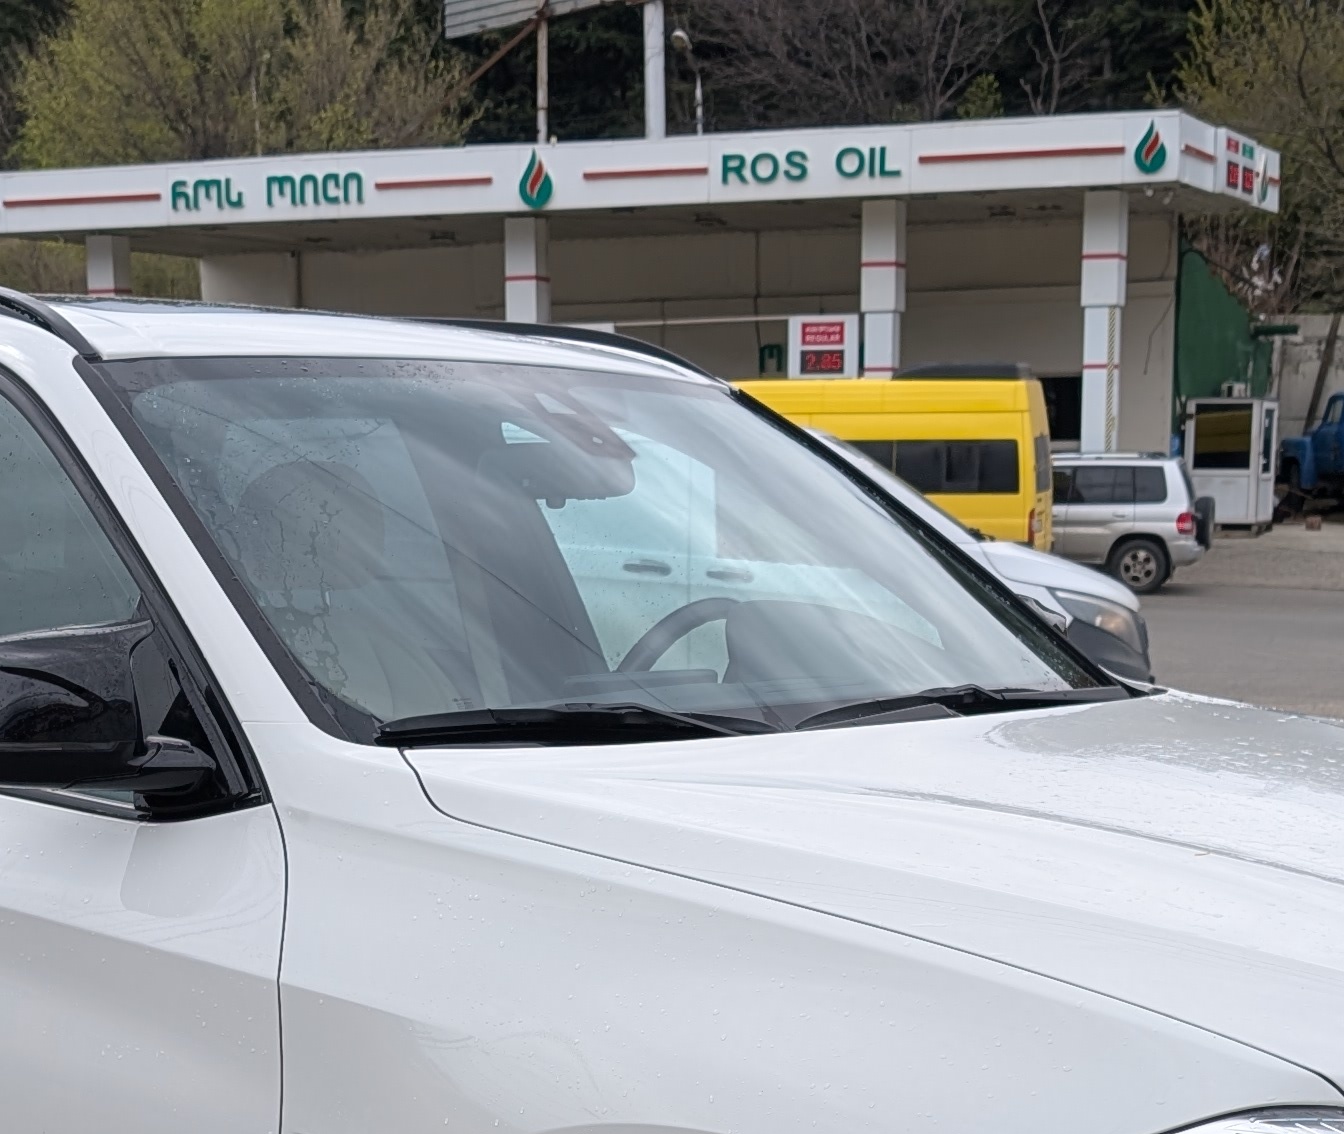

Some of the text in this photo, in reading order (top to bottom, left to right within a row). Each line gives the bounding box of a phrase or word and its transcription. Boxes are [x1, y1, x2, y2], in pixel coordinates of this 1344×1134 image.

[721, 146, 902, 185] ROS OIL
[171, 172, 364, 211] როს ოილი
